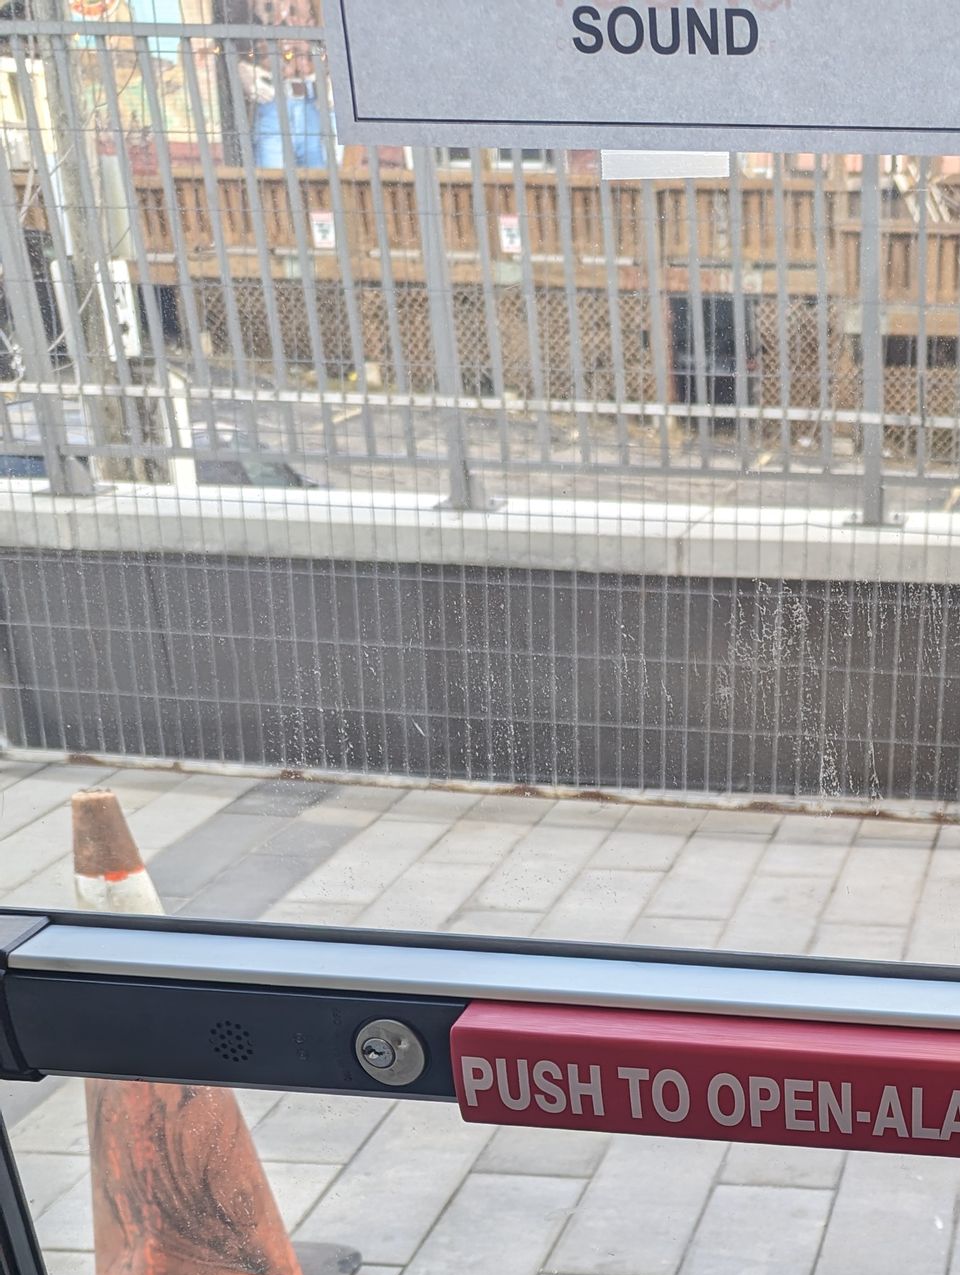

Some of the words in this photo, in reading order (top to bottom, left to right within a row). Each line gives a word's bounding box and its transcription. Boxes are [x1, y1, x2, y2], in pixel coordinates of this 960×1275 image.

[572, 5, 759, 55] SOUND
[461, 1056, 605, 1116] PUSH
[618, 1066, 690, 1123] TO
